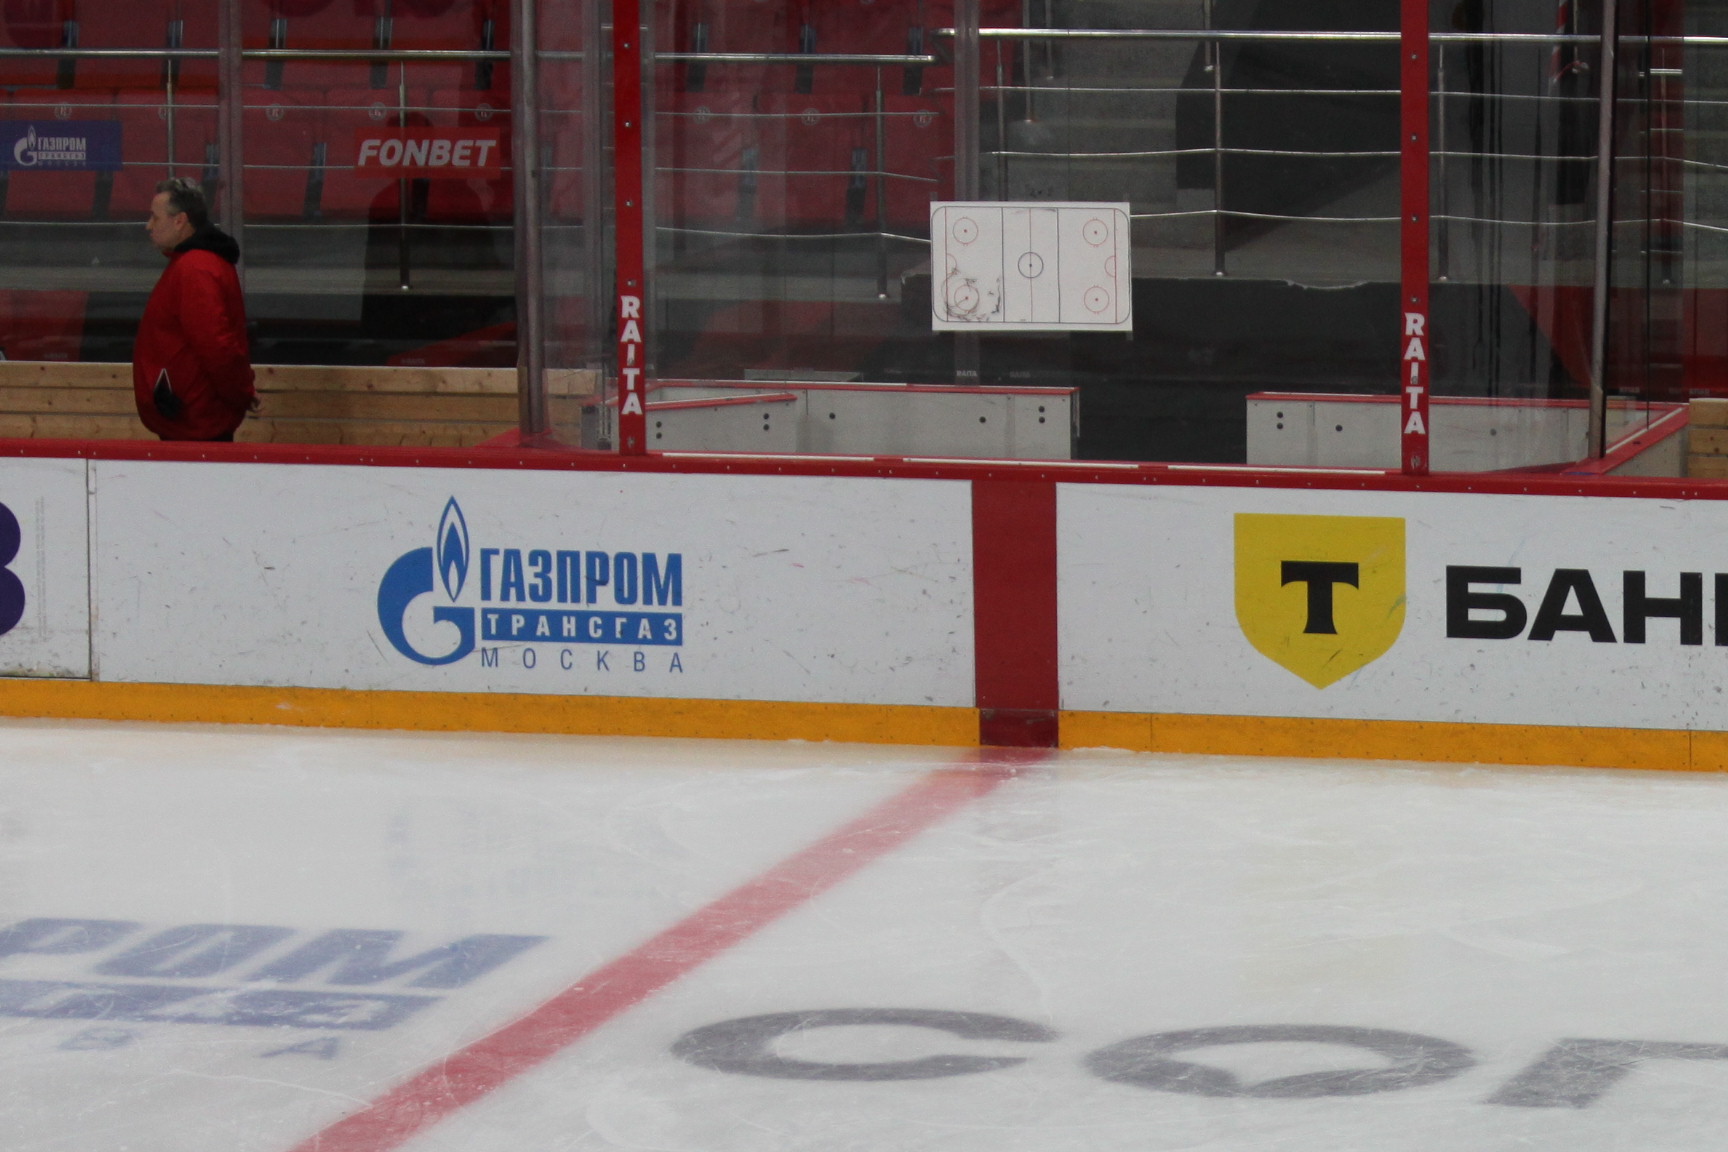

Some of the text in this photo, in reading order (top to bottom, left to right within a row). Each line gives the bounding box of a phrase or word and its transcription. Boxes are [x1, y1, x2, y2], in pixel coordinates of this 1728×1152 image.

[37, 137, 87, 151] ГАЗПРОМ
[356, 138, 498, 168] FONBET
[620, 295, 642, 416] RAITA
[1404, 312, 1426, 435] RAITA
[480, 548, 684, 607] ГАЗПРОМ
[1280, 560, 1360, 636] Т
[486, 613, 678, 641] ТРАНСГАЗ
[480, 647, 685, 674] МОСКВА
